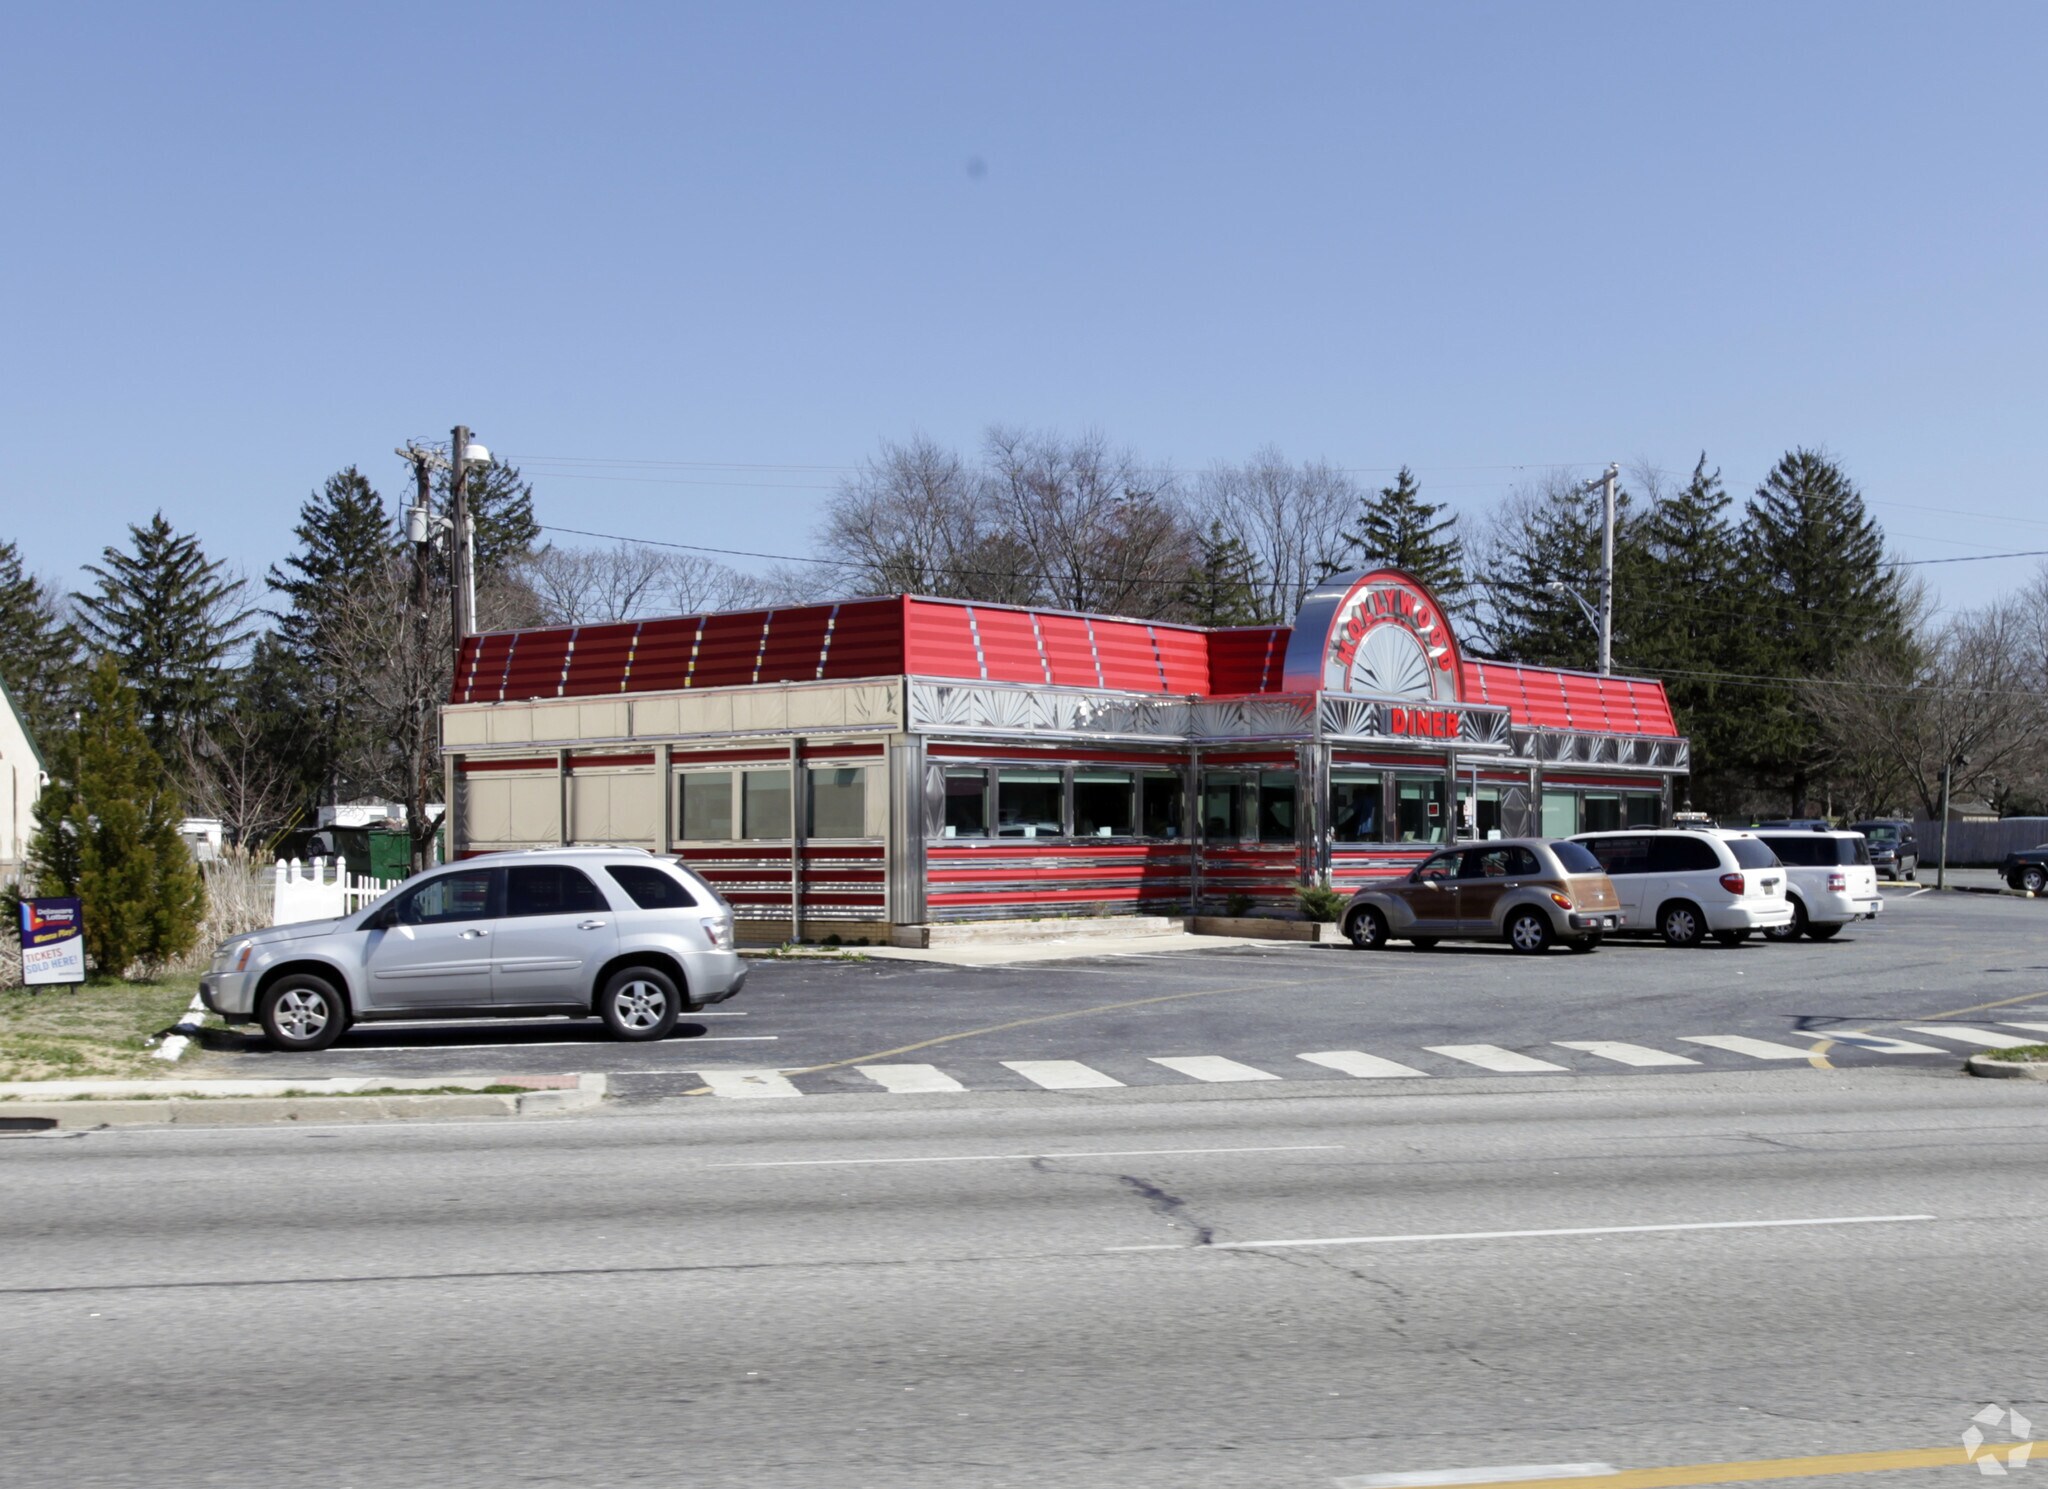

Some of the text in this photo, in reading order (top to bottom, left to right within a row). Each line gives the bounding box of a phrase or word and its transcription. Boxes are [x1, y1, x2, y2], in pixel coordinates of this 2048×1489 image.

[1337, 589, 1452, 672] HOLLYWOOD
[1392, 708, 1459, 738] DINER
[58, 926, 77, 937] Play?
[25, 955, 78, 974] SOLD HERE!
[26, 948, 63, 963] TICKETS
